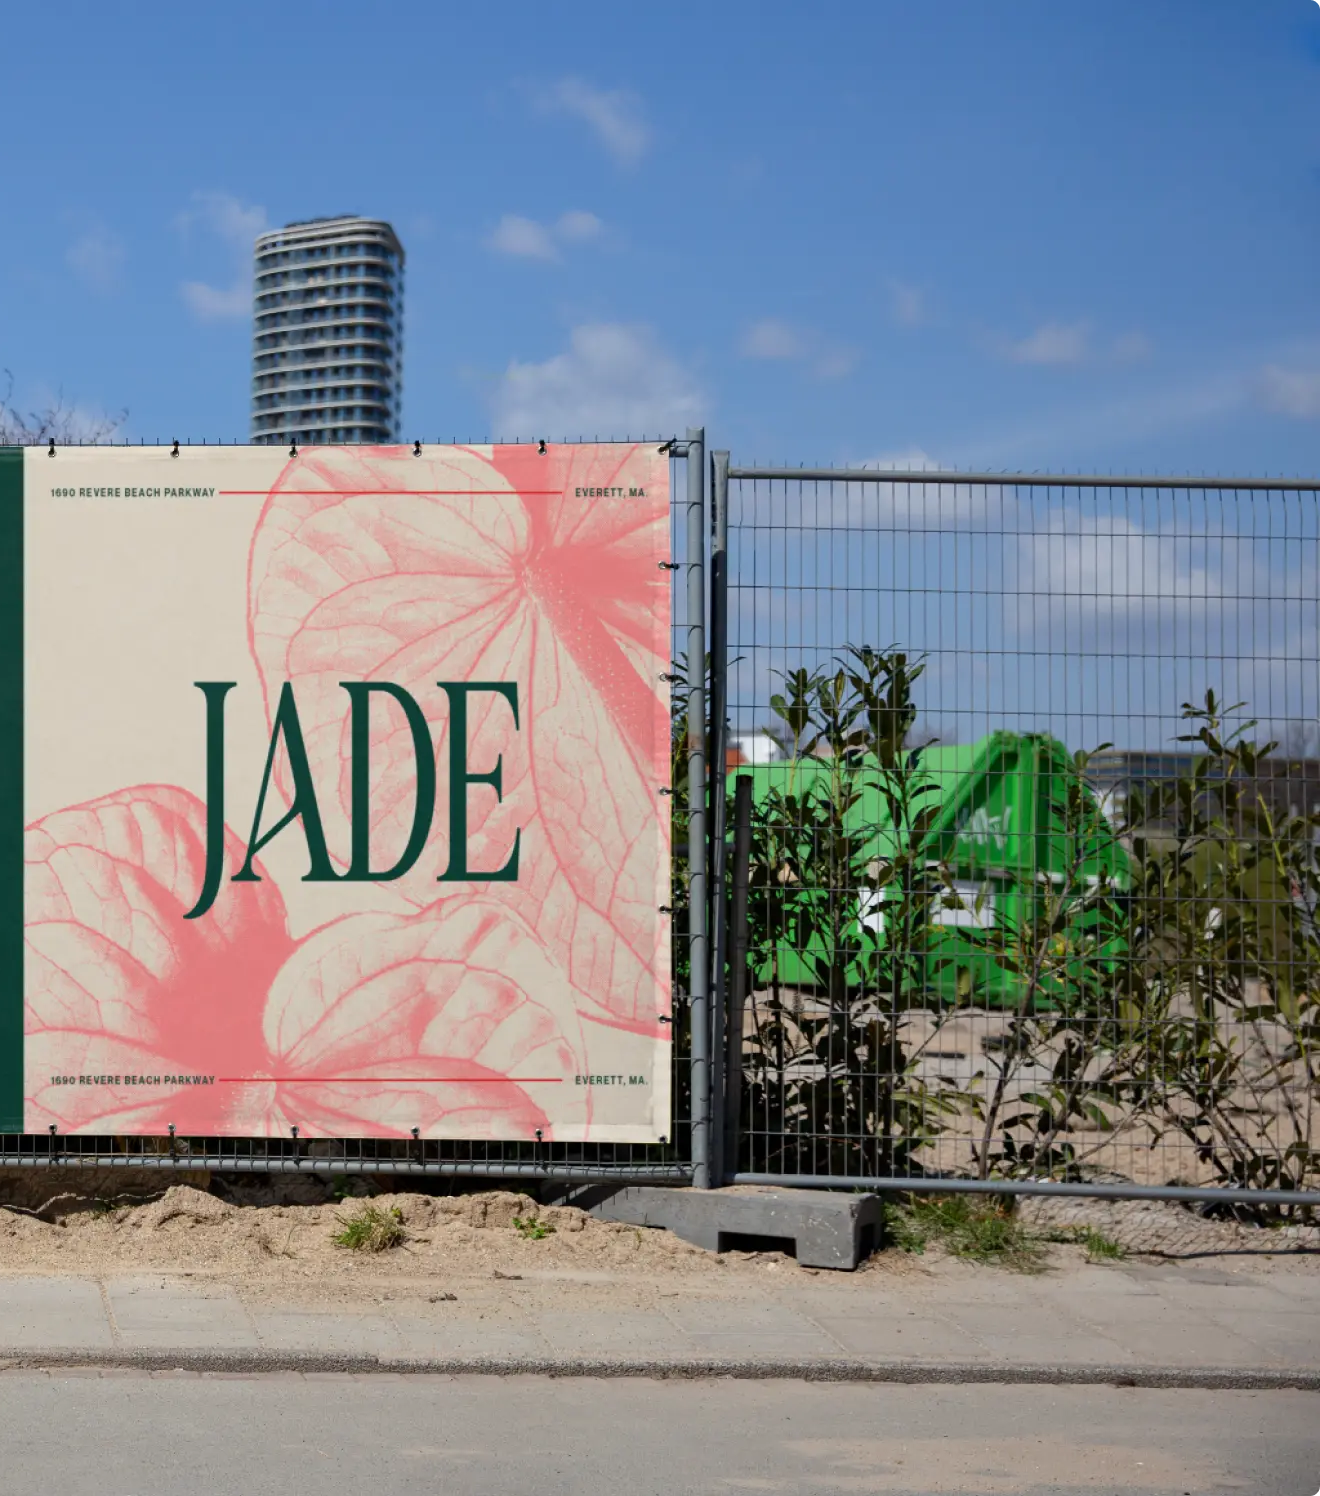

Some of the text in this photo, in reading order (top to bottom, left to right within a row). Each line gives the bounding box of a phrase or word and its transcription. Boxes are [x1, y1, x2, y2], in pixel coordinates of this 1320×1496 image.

[51, 487, 215, 498] 1690 REVERE BEACH PARKWAY
[575, 487, 648, 499] EVERETT, MA.
[183, 681, 521, 919] JADE
[51, 1075, 215, 1086] 1690 REVERE BEACH PARKWAY
[575, 1075, 648, 1087] EVERETT, MA.
